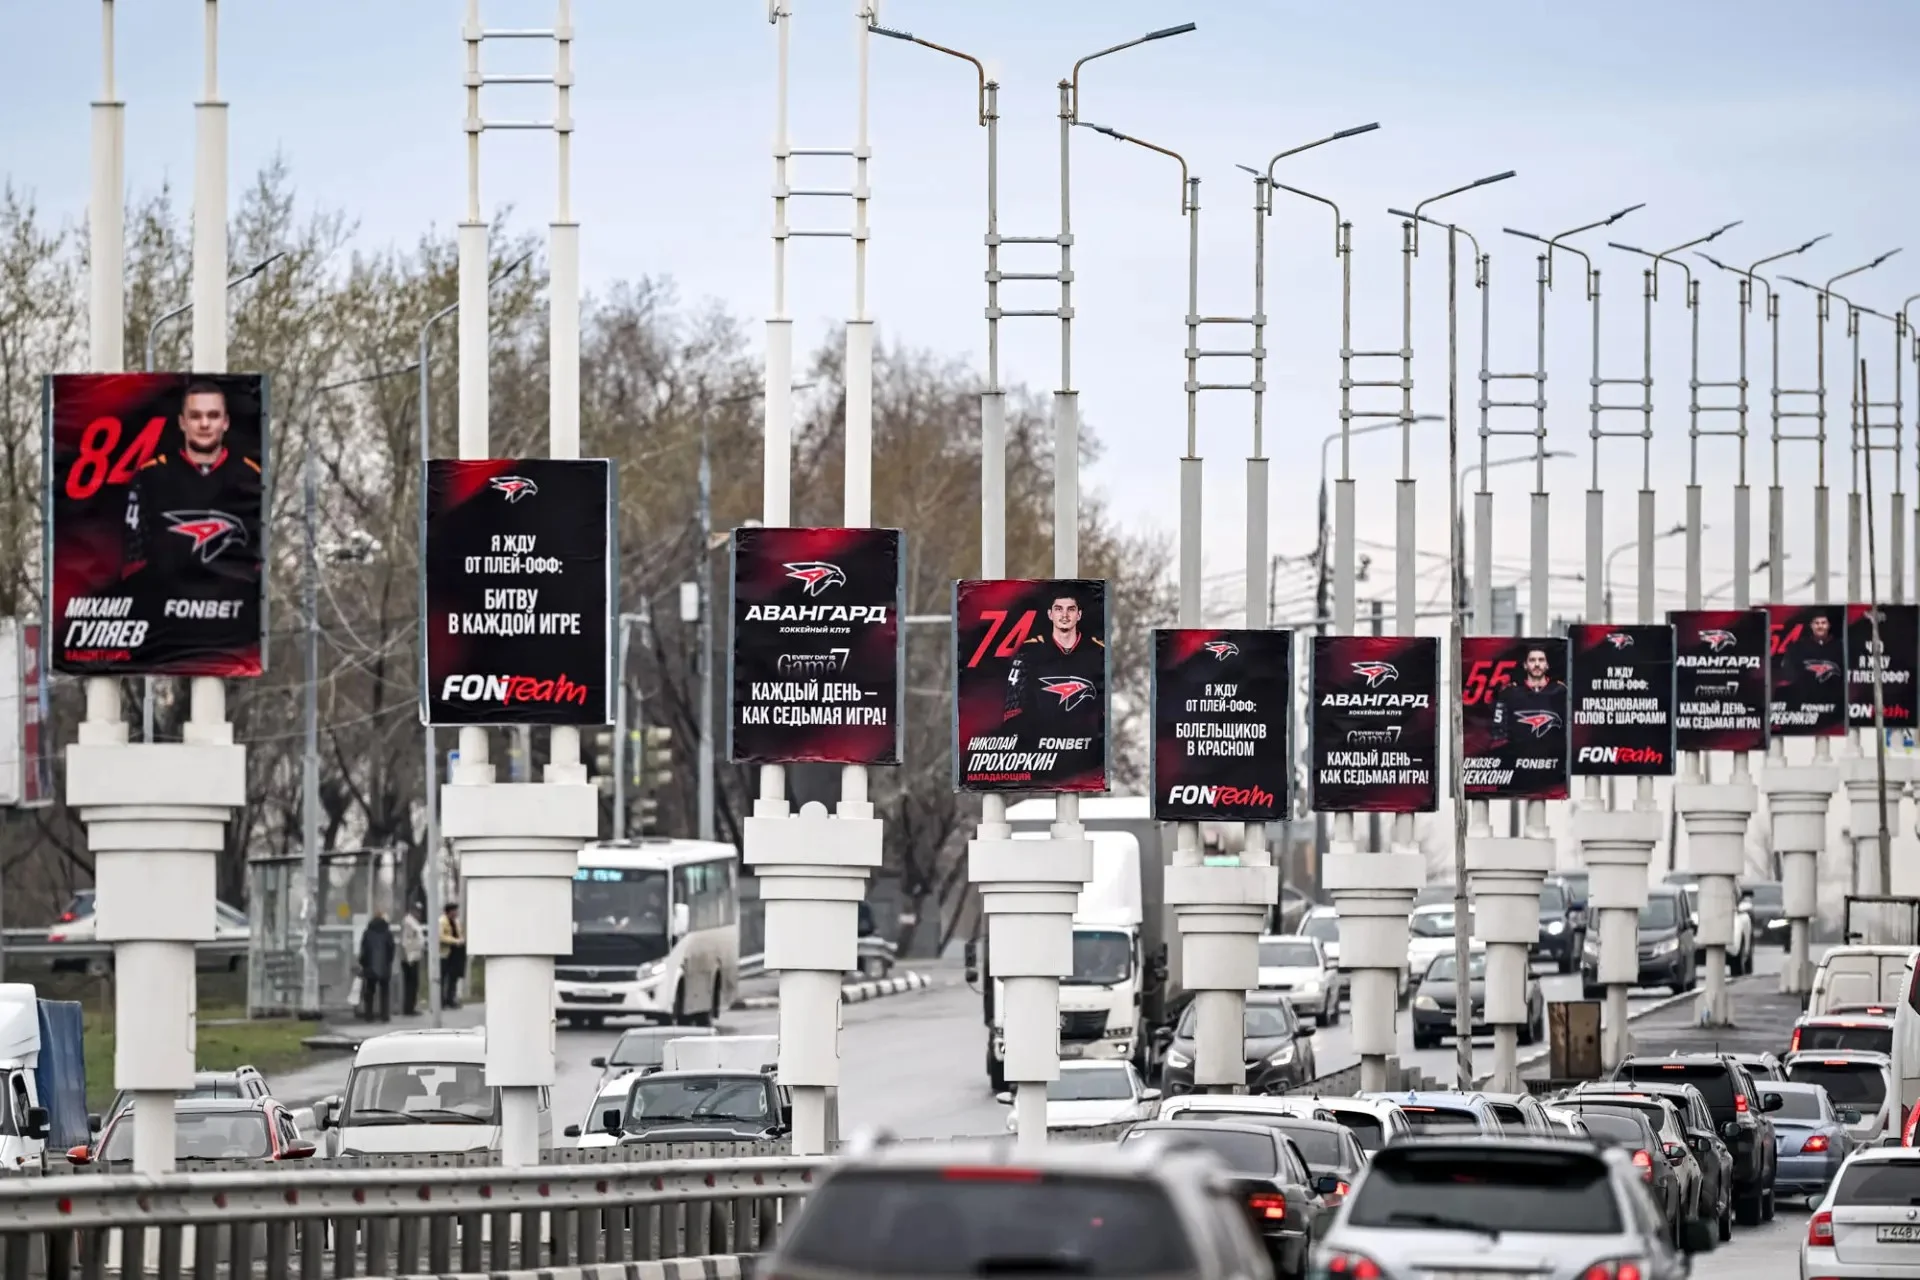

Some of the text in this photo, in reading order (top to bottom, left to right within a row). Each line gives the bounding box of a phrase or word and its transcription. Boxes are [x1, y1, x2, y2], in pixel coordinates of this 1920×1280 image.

[65, 416, 166, 499] 84
[491, 535, 536, 555] Я ЖДУ
[465, 553, 563, 574] ОТ ПЛЕЙ-ОФФ:
[64, 597, 133, 618] МИХАИЛ
[485, 588, 538, 610] БИТВУ
[164, 599, 243, 618] FONBET
[744, 605, 887, 624] АВАНГАРД
[449, 609, 581, 637] В КАЖДОЙ ИГРЕ
[779, 625, 828, 634] ХОККЕЙНЫЙ
[64, 620, 149, 647] ГУЛЯЕВ
[966, 610, 1037, 668] 74
[830, 648, 850, 673] 7
[1676, 656, 1760, 669] АВАНГАРД
[1607, 667, 1633, 679] Я ЖДУ
[752, 679, 818, 702] КАЖДЫЙ
[822, 683, 861, 702] ДЕНЬ
[1205, 684, 1238, 698] Я ЖДУ
[1463, 660, 1517, 705] 55
[1592, 680, 1601, 690] ОТ
[1186, 697, 1257, 712] ОТ ПЛЕЙ-ОФФ:
[1322, 694, 1430, 709] АВАНГАРД
[1583, 698, 1658, 711] ПРАЗДНОВАНИЯ
[1680, 700, 1720, 714] КАЖДЫЙ
[1722, 703, 1746, 715] ДЕНЬ
[742, 706, 887, 727] КАК СЕДЬМАЯ ИГРА!
[1575, 712, 1666, 724] ГОЛОВ С ШАРФАМИ
[1693, 717, 1735, 729] СЕДЬМАЯ
[1736, 717, 1761, 729] ИГРА!
[1176, 723, 1267, 740] БОЛЕЛЬЩИКОВ
[968, 734, 1018, 751] НИКОЛАЙ
[1039, 737, 1092, 750] FONBET
[1187, 741, 1254, 757] В КРАСНОМ
[968, 753, 1058, 771] ПРОХОРКИН
[1327, 749, 1378, 767] КАЖДЫЙ
[1381, 752, 1410, 767] ДЕНЬ
[1463, 757, 1501, 769] ДЖОЗЕФ
[1516, 758, 1558, 769] FONBET
[968, 772, 1031, 781] НАПАДАЮЩИЙ
[1320, 769, 1429, 785] КАК СЕДЬМАЯ ИГРА!
